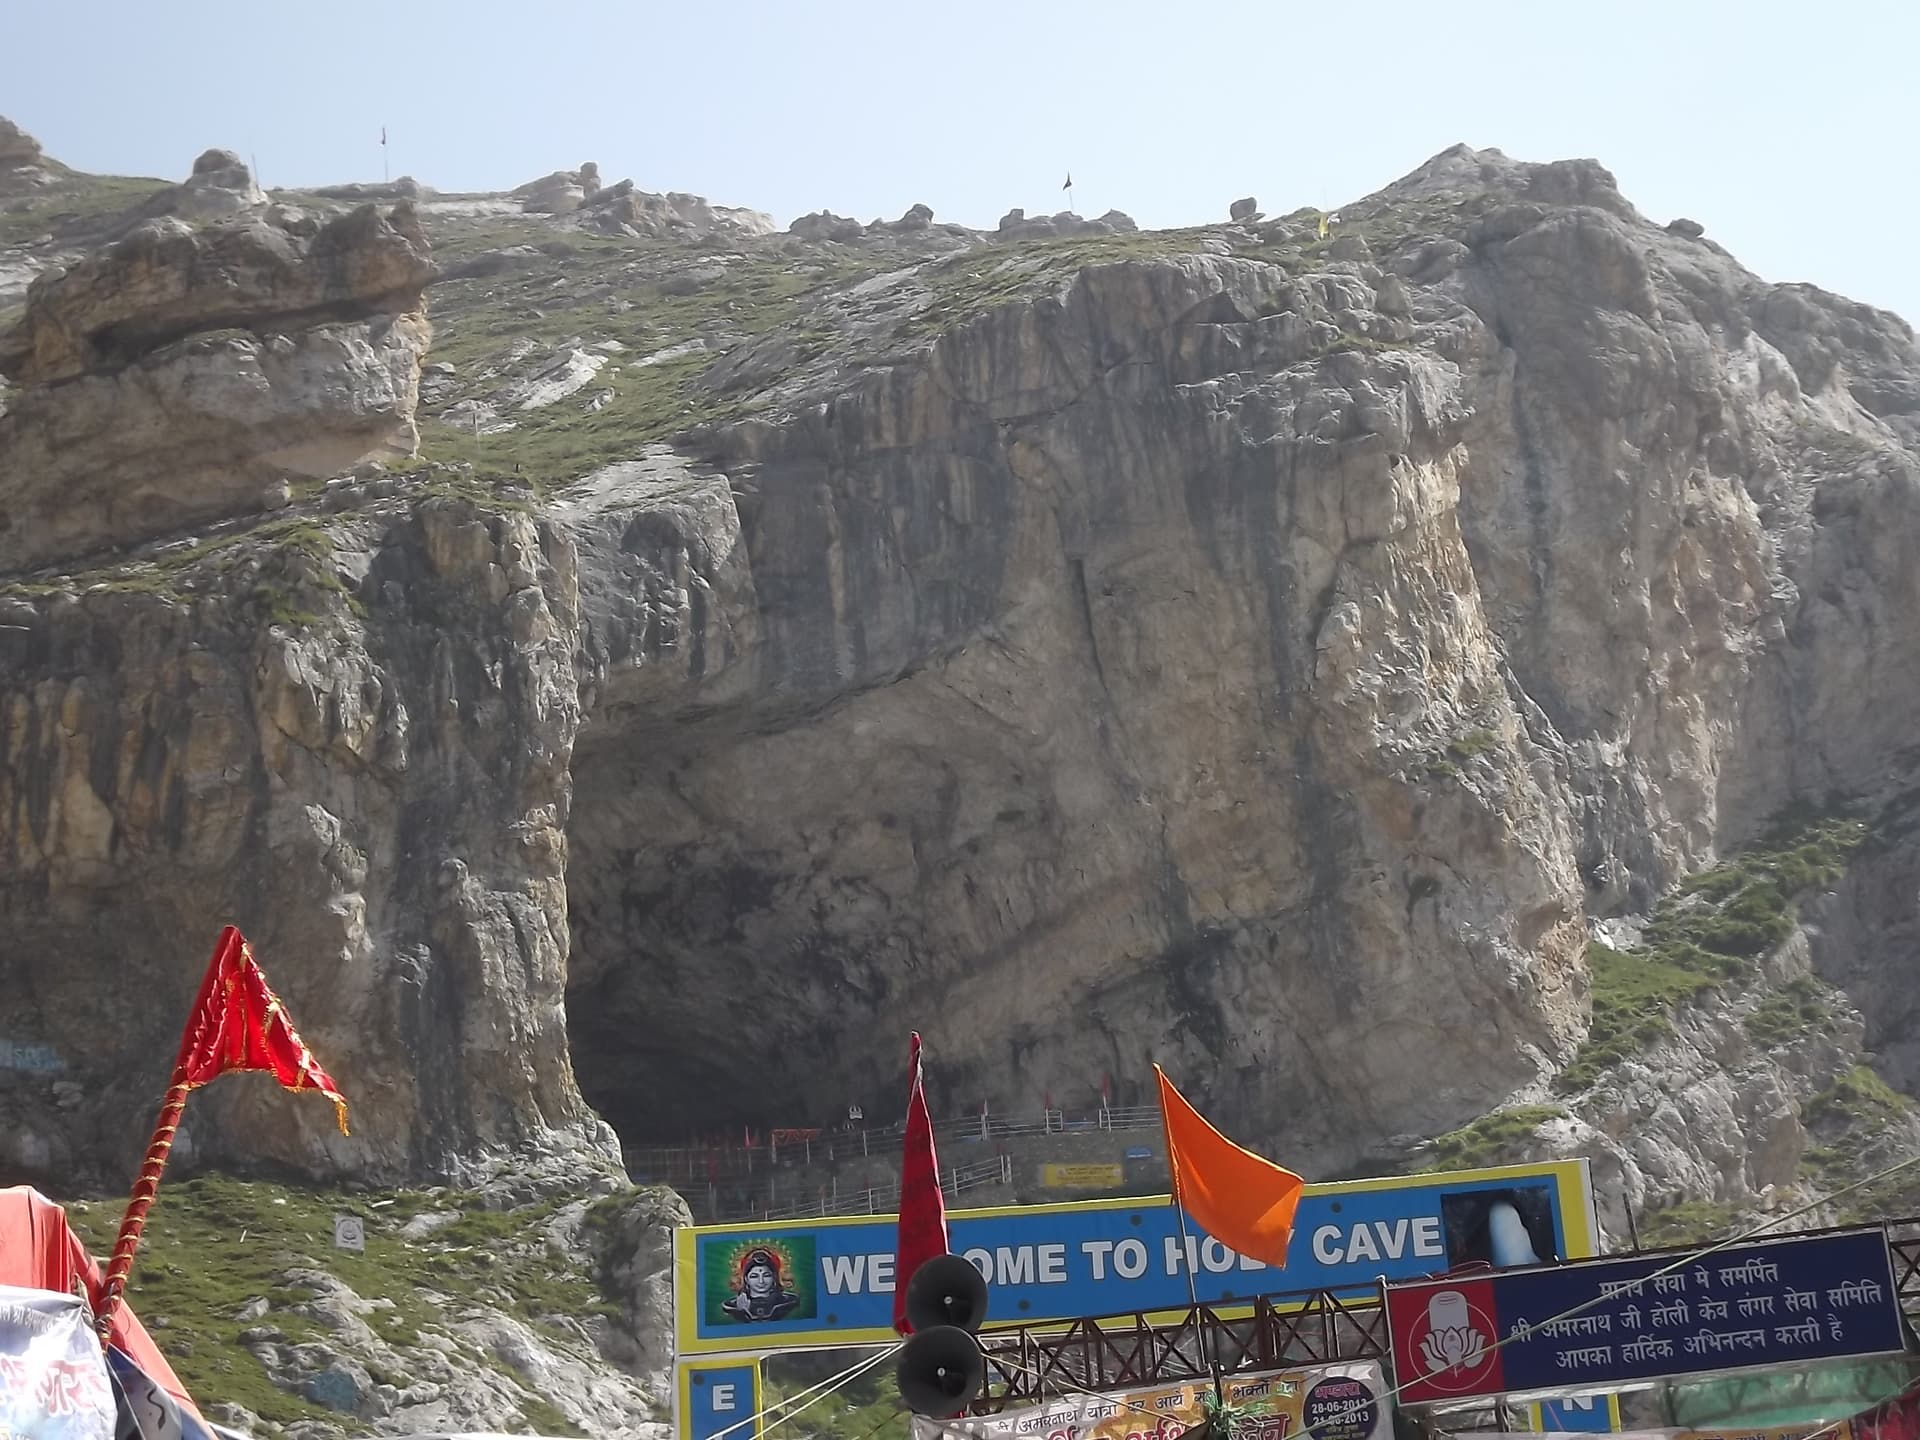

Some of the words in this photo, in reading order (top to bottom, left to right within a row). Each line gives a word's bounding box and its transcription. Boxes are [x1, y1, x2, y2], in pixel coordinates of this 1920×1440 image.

[821, 1244, 1067, 1295] WEOME
[1082, 1238, 1148, 1280] TO
[1163, 1227, 1295, 1276] HO
[1312, 1216, 1444, 1266] CAVE
[1598, 1278, 1644, 1300] मानव
[1653, 1270, 1686, 1295] सेवा
[1718, 1257, 1779, 1287] समर्पित
[1510, 1317, 1532, 1343] श्री
[1541, 1314, 1612, 1339] अमरनाथ
[1619, 1304, 1642, 1330] जी
[1651, 1298, 1690, 1328] होली
[1697, 1295, 1729, 1321] केव
[1737, 1291, 1776, 1318] लंगर
[1784, 1286, 1818, 1313] सेवा
[1826, 1278, 1882, 1308] समिति
[1555, 1345, 1613, 1369] आपका
[1621, 1333, 1674, 1364] हार्दिक
[1684, 1328, 1767, 1354] अभिनन्दन
[1774, 1316, 1821, 1345] करती
[1827, 1313, 1844, 1342] है
